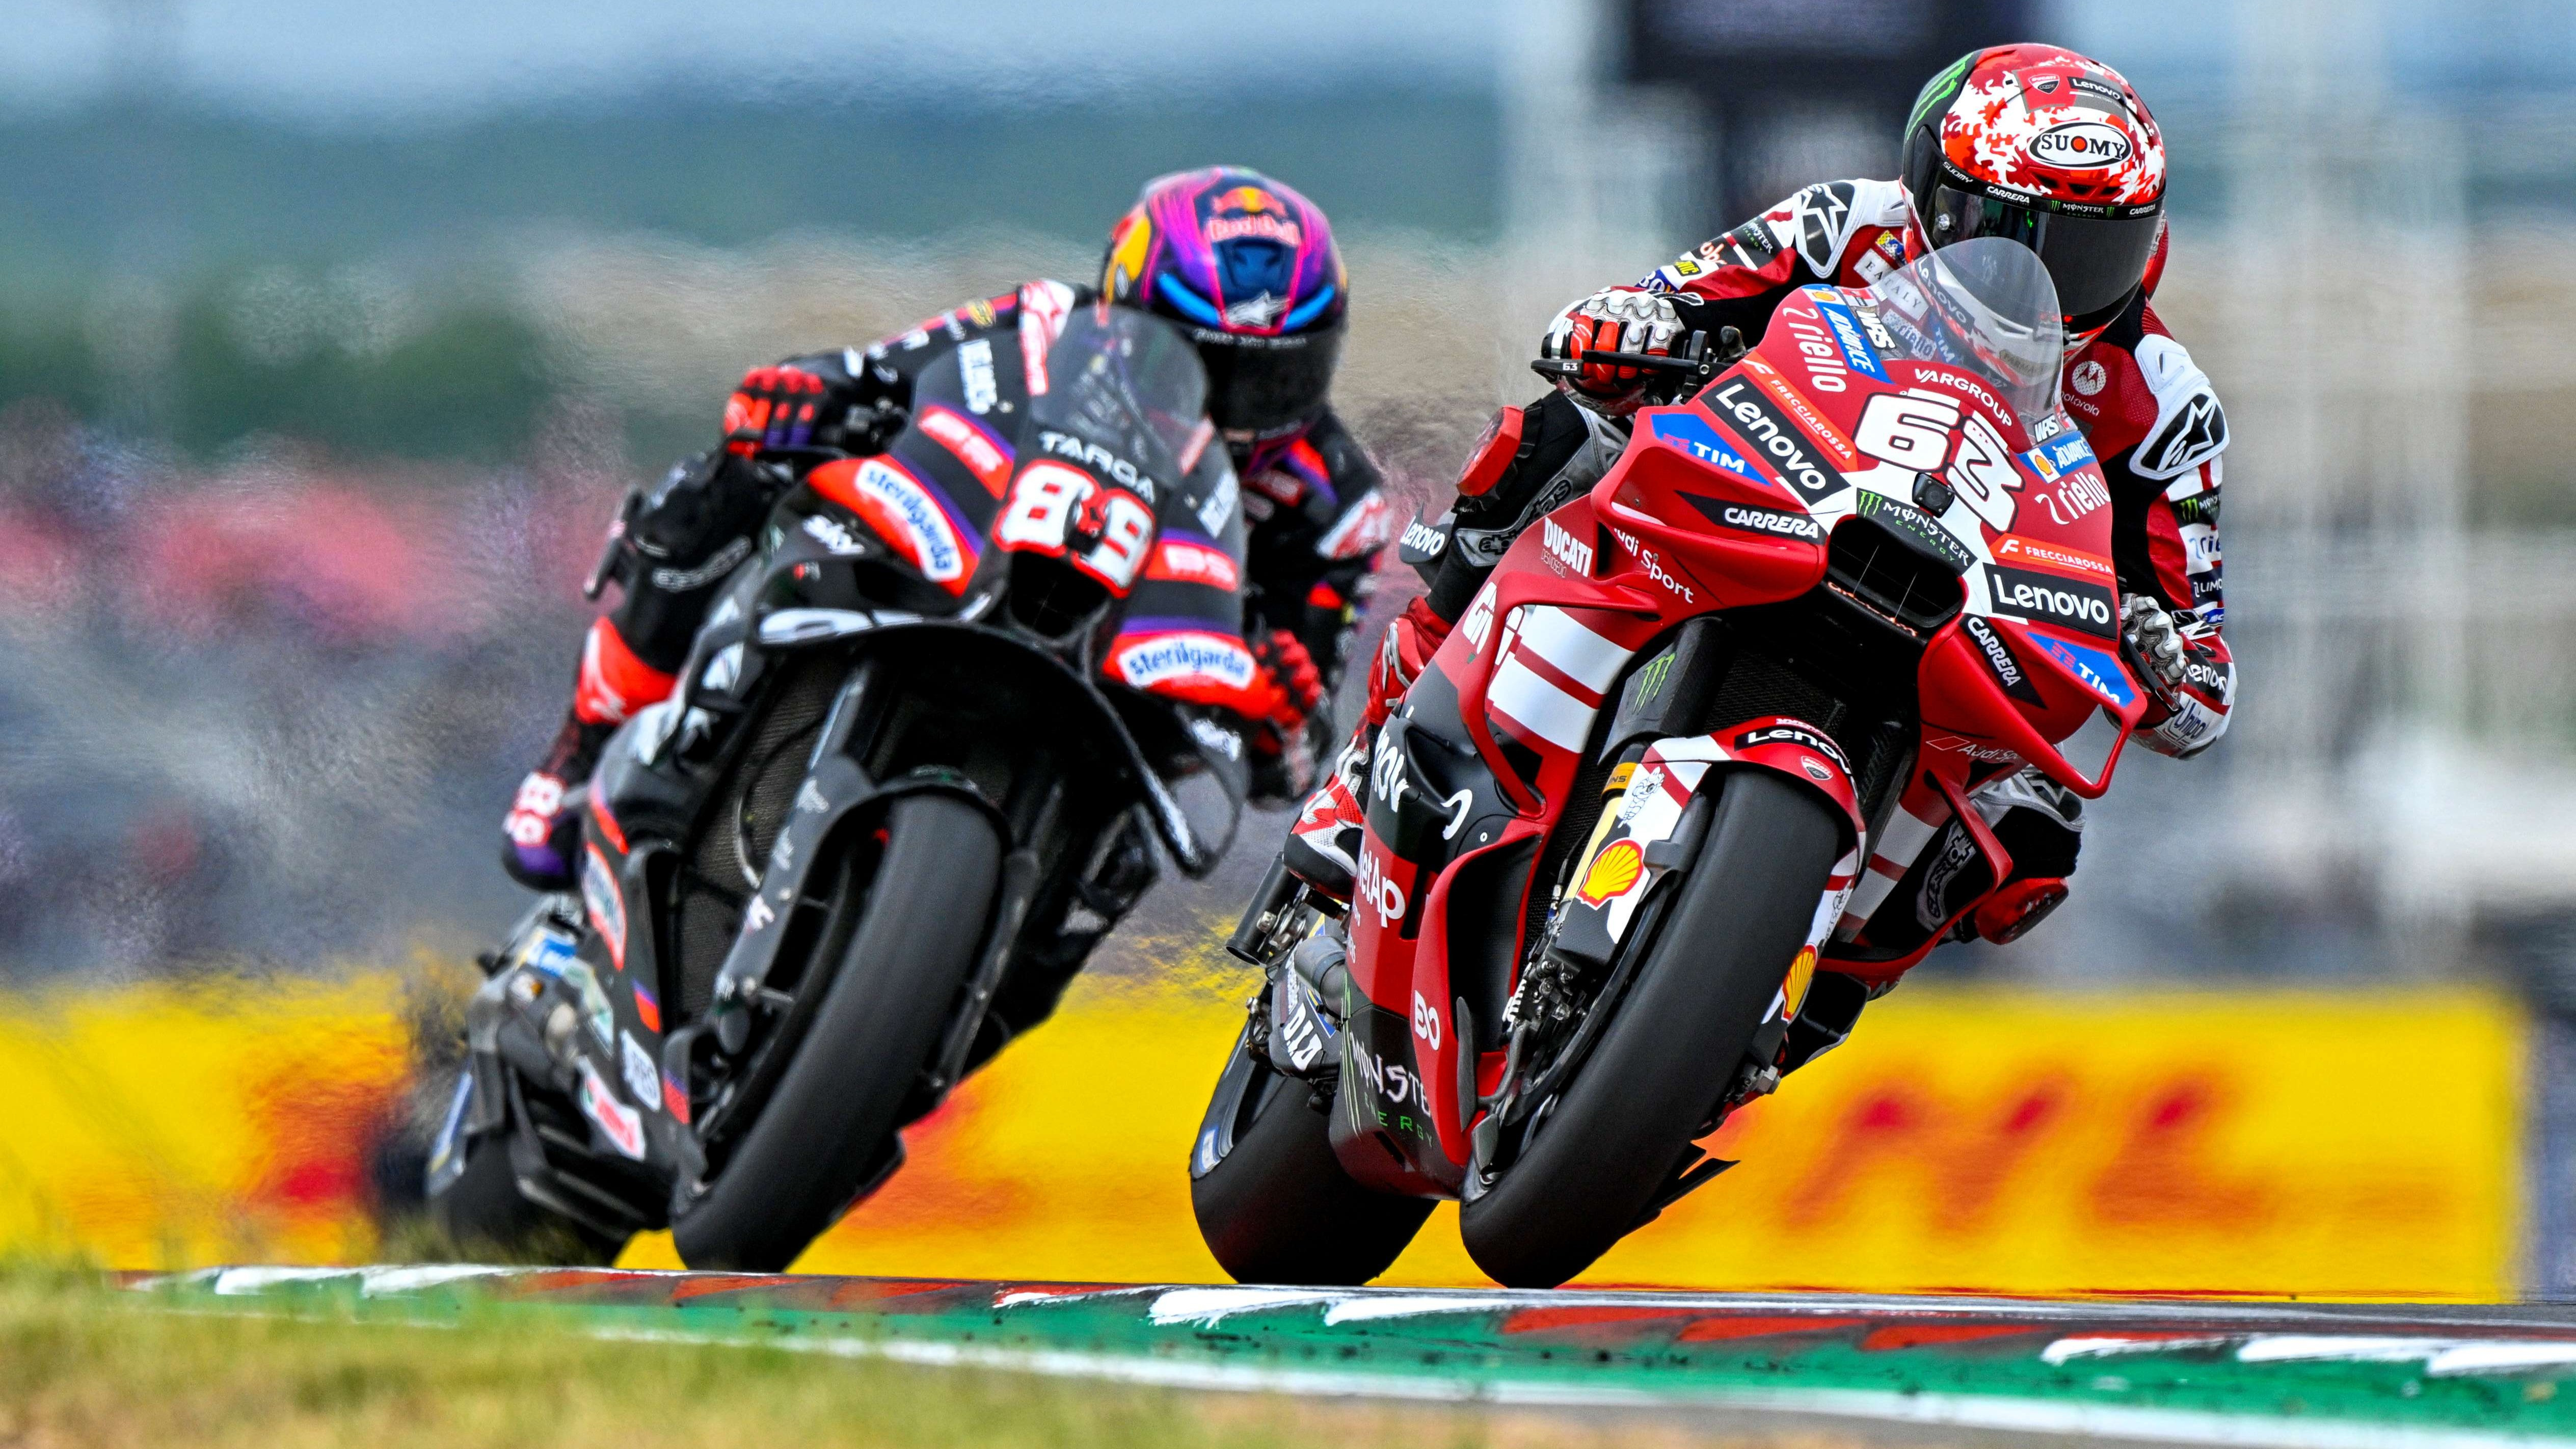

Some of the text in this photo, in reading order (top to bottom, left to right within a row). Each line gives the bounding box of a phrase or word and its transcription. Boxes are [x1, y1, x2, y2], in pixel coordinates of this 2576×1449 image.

[2072, 78, 2121, 100] Lenovo
[2041, 133, 2125, 159] SUOMY
[1943, 162, 1974, 183] SUOMY
[1987, 185, 2030, 204] CARRERA
[2063, 203, 2104, 213] MONSTER
[1919, 256, 1967, 325] Lenovo
[1562, 362, 1578, 372] 63
[1788, 321, 1847, 393] riello
[1716, 383, 1827, 490] Lenovo
[1770, 380, 1853, 460] FRECCIAROSSA
[1038, 430, 1156, 504] TARGA
[1694, 442, 1745, 474] TIM
[1855, 389, 2025, 533] 63
[2058, 471, 2111, 520] riello
[1400, 515, 1445, 555] Lenovo
[1544, 516, 1593, 578] DUCATI
[1725, 507, 1819, 539] CARRERA
[1883, 502, 1971, 567] MONSTER
[1895, 519, 1955, 561] ENERGY
[1614, 528, 1694, 604] udi Sport
[2025, 546, 2113, 574] FRECCIAROSSA
[1994, 574, 2109, 625] Lenovo
[1968, 616, 2021, 687] CARRERA
[2078, 662, 2120, 704] TIM
[1350, 1032, 1431, 1118] MONSTE
